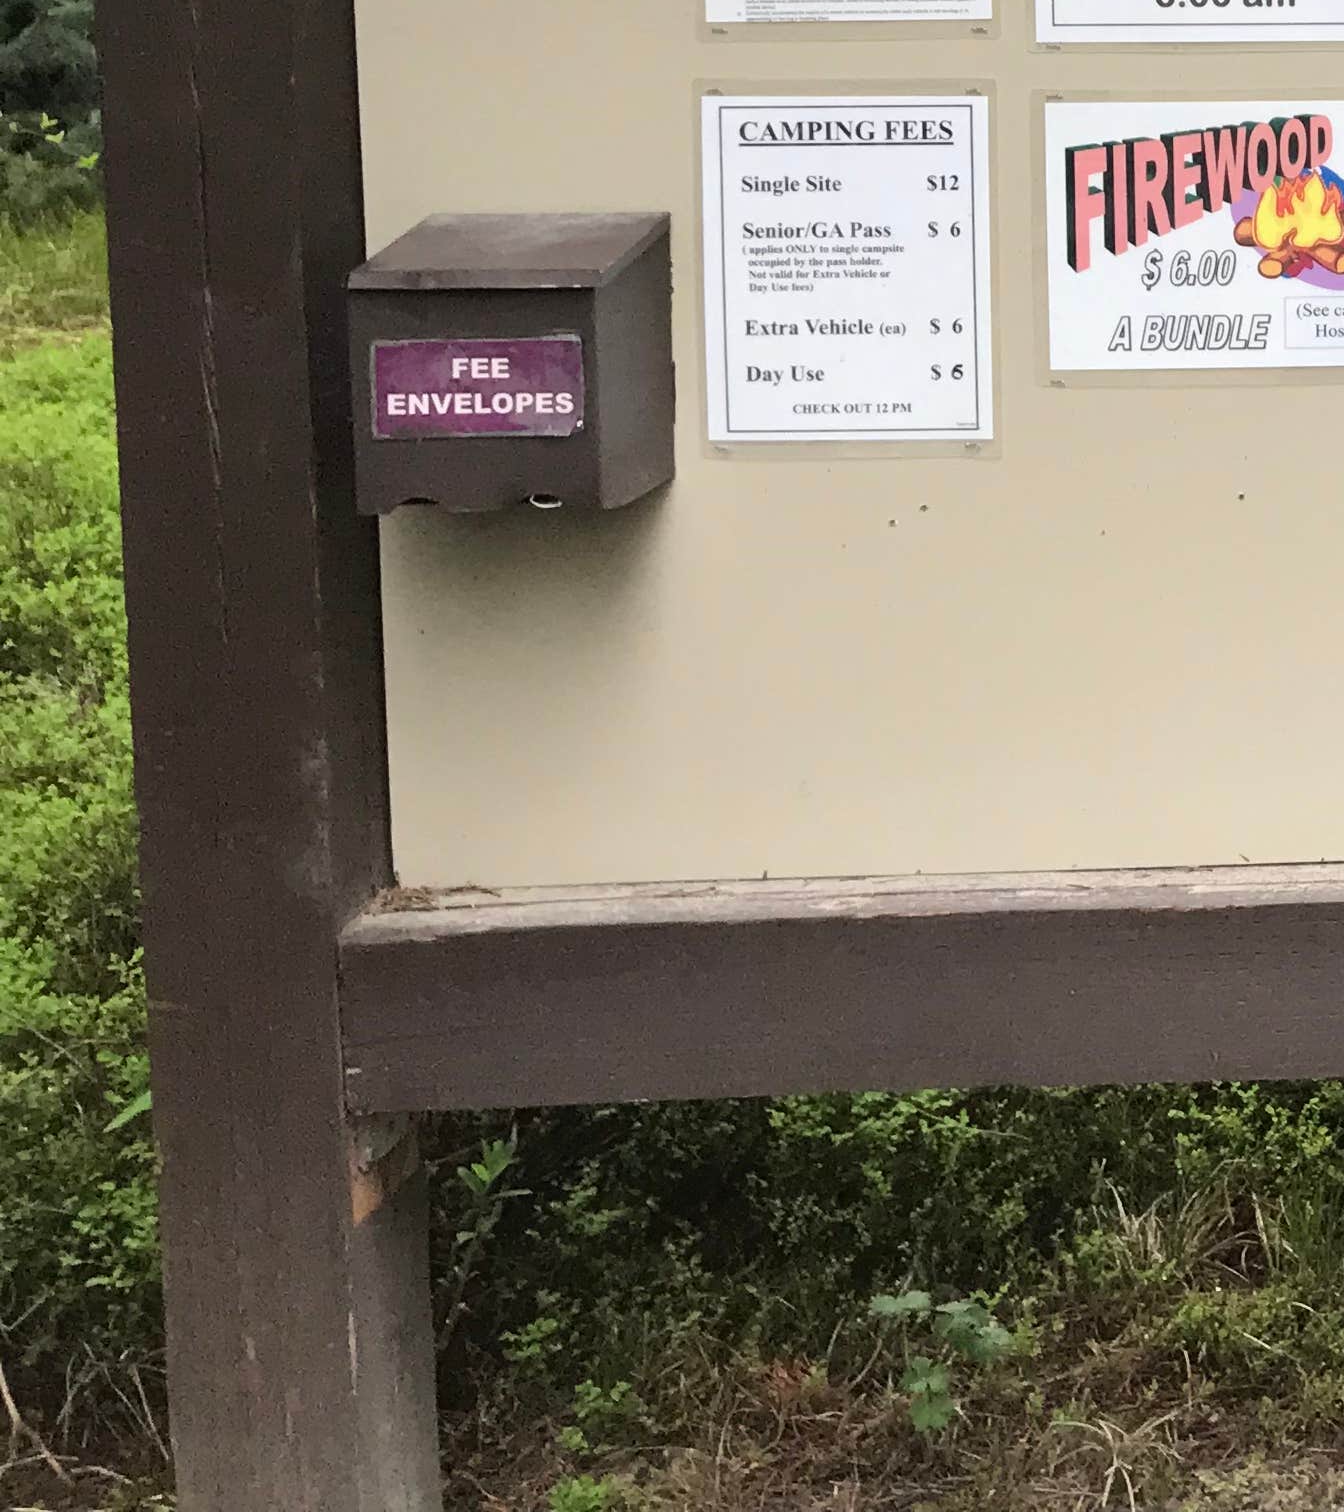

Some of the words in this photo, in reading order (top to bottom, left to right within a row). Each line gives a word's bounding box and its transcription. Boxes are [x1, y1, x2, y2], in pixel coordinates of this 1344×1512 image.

[738, 120, 874, 141] CAMPING
[884, 120, 952, 140] FEES
[741, 176, 800, 196] Single
[806, 175, 841, 192] Site
[926, 175, 958, 191] $12
[1065, 114, 1333, 273] FIREWOOD
[742, 222, 844, 239] Senior/GA
[850, 222, 891, 237] Pass
[1141, 249, 1163, 290] $
[1169, 250, 1236, 286] 6.00
[1296, 303, 1329, 320] (See
[745, 320, 798, 335] Extra
[804, 318, 873, 334] Vehicle
[879, 322, 906, 336] (ea)
[1108, 316, 1132, 351] A
[1141, 314, 1271, 351] BUNDLE
[451, 358, 510, 378] FEE
[746, 366, 782, 386] Day
[790, 365, 824, 381] Use
[387, 392, 573, 414] ENVELOPES
[792, 403, 840, 414] CHECK
[843, 403, 872, 413] OUT
[876, 403, 888, 413] 12
[892, 403, 912, 413] PM
